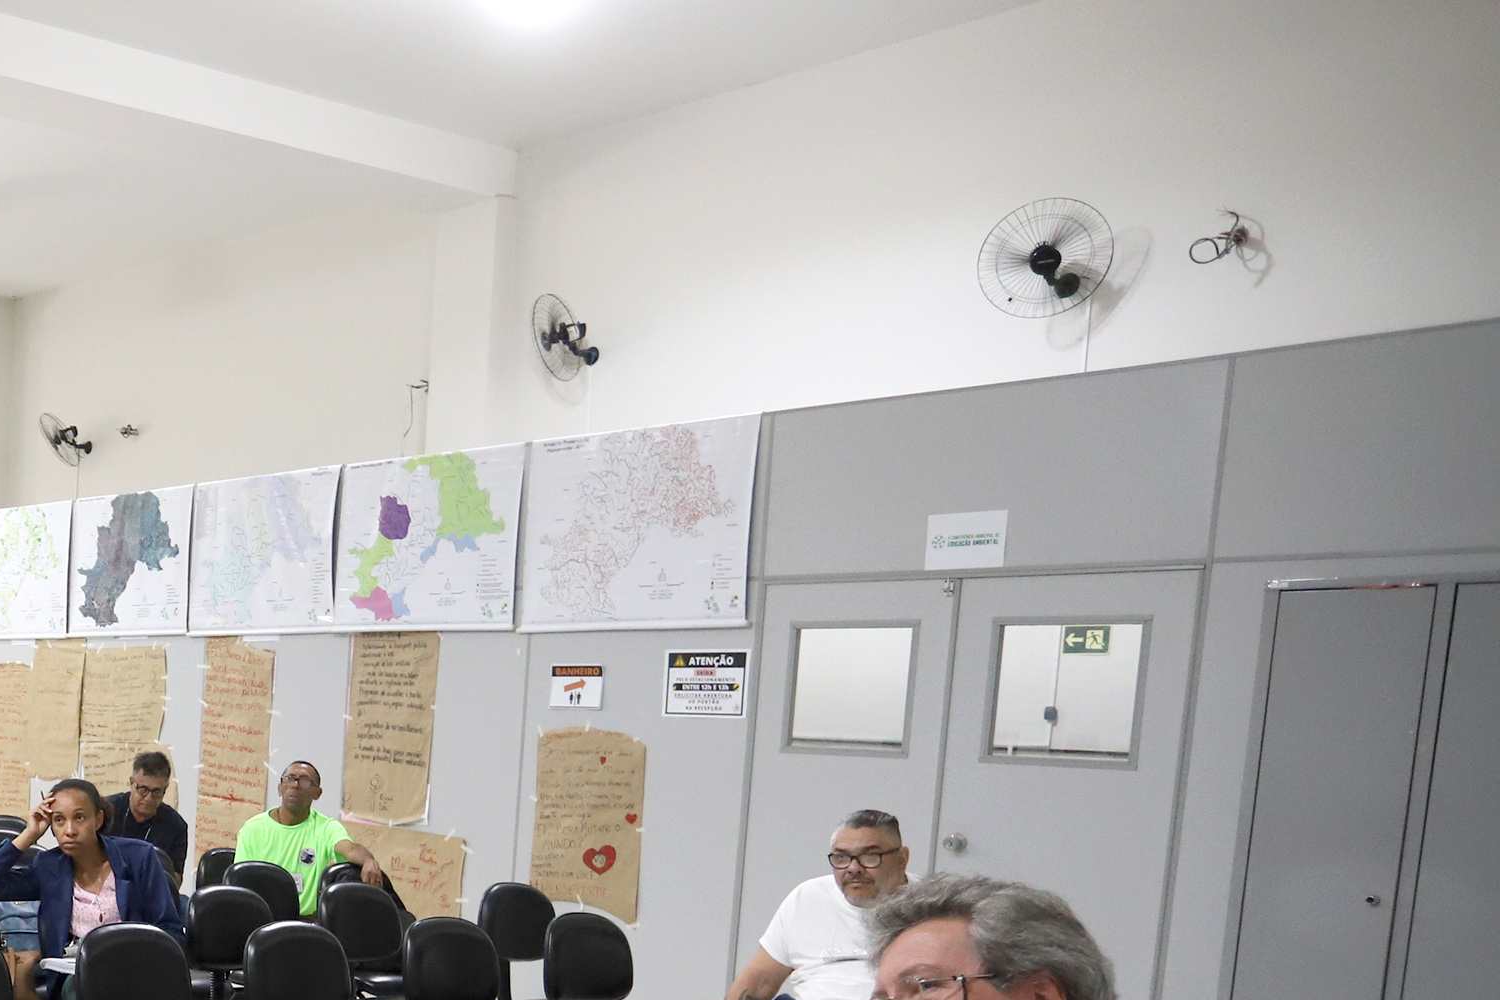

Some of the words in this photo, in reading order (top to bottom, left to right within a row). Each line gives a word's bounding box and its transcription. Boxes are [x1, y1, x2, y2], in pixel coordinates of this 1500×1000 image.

[688, 654, 734, 668] ATENÇÃO
[555, 667, 600, 676] BANHEIRO
[696, 668, 714, 676] SAÍDA
